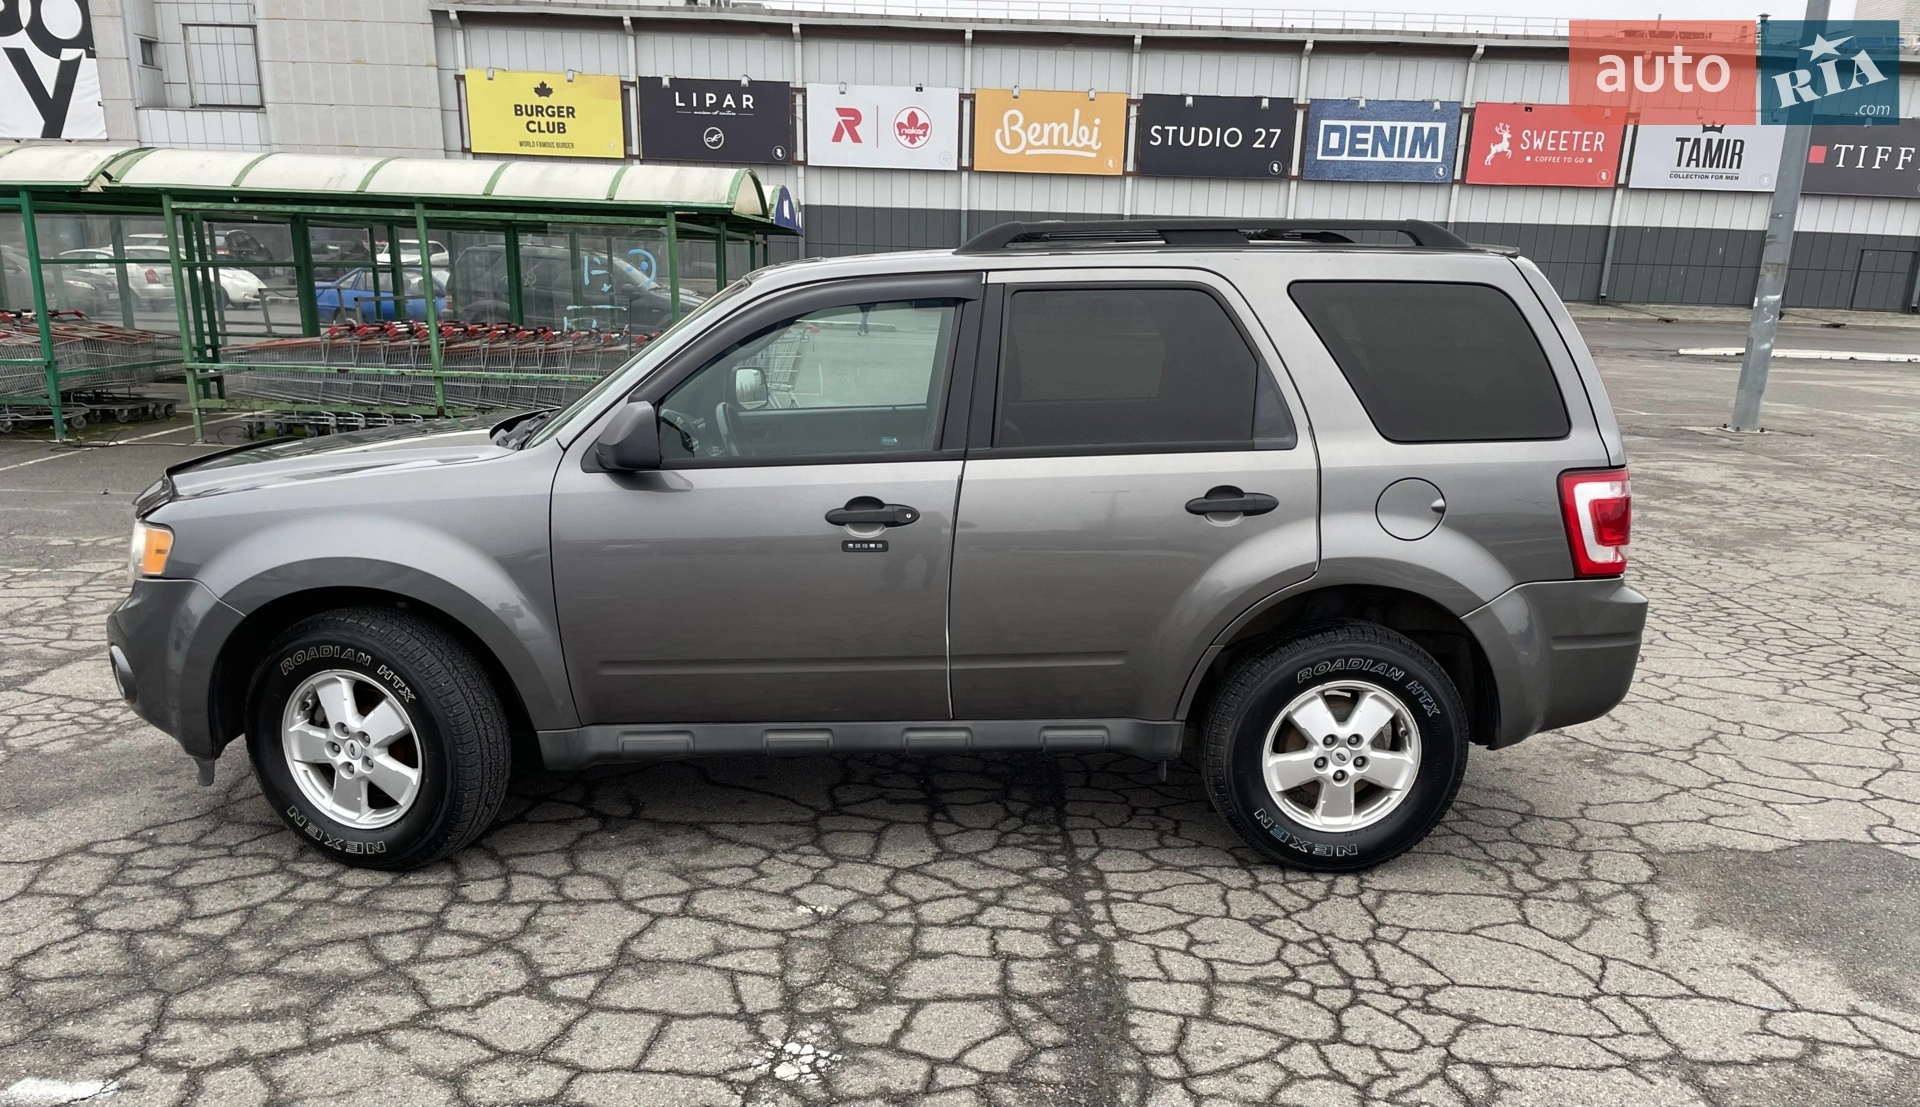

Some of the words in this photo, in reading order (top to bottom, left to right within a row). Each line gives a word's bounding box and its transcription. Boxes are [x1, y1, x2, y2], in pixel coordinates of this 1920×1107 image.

[513, 104, 576, 119] BURGER
[675, 91, 754, 109] LIPAR
[526, 120, 567, 134] CLUB
[994, 108, 1102, 155] Bembi
[1150, 125, 1243, 148] STUDIO
[1252, 128, 1282, 149] 27
[1520, 129, 1605, 152] SWEETER
[519, 140, 536, 148] WORLD
[536, 141, 555, 149] FAMOUS
[1321, 124, 1440, 159] DENIM
[1675, 137, 1746, 169] TAMIR
[1534, 155, 1561, 163] COFFEE
[1833, 143, 1920, 171] TIFF
[280, 645, 372, 676] ROADIAN
[377, 664, 416, 703] HTX
[1297, 658, 1405, 684] ROADIAN
[1405, 680, 1441, 718] HTX
[287, 805, 387, 855] NEXEN
[1254, 808, 1358, 857] NEXEN
